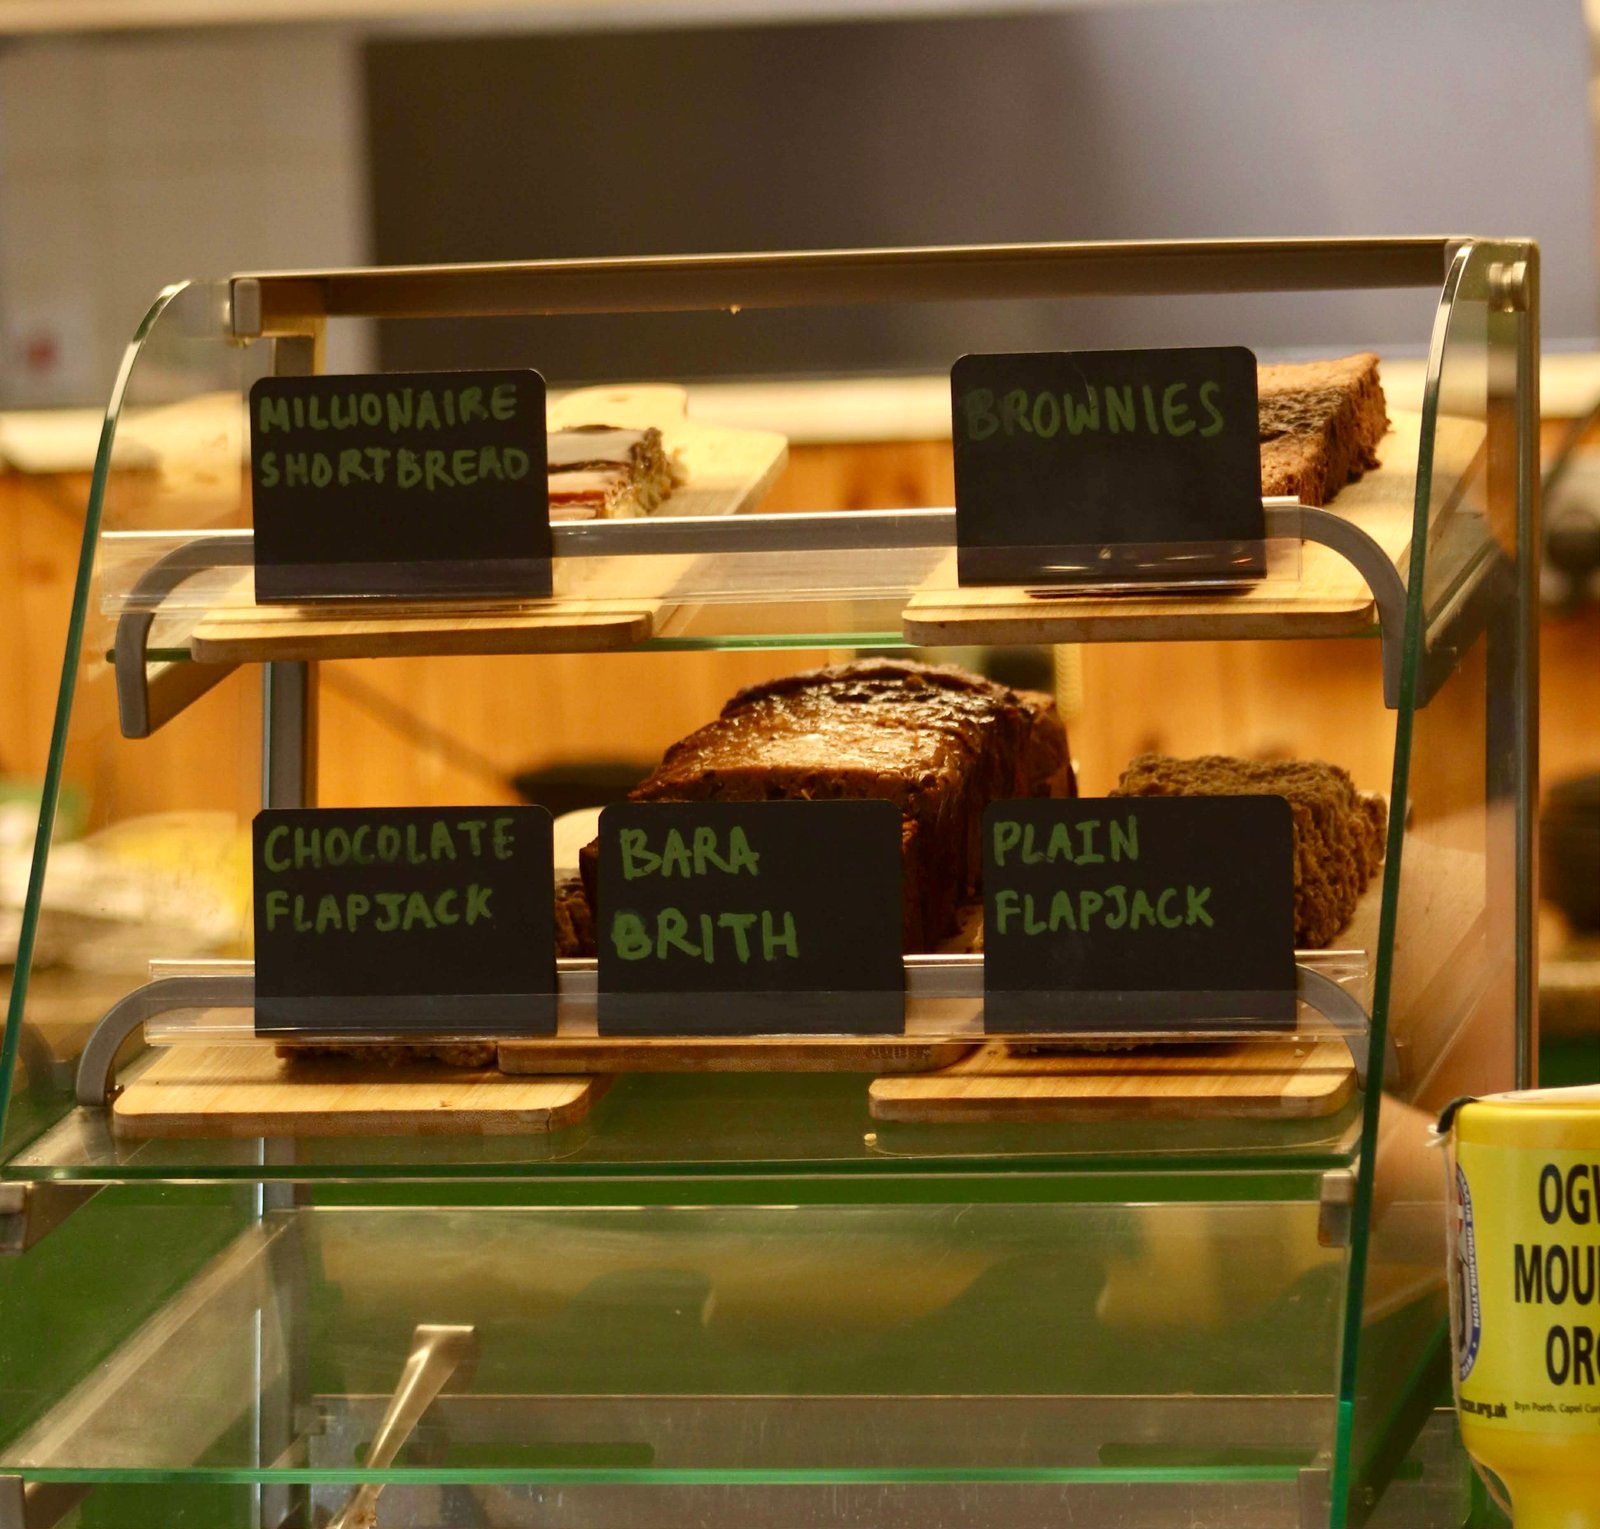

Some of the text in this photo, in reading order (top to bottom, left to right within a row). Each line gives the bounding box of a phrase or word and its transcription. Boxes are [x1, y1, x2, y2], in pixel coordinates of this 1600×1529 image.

[258, 384, 517, 433] MILLIONAIRE
[962, 380, 1224, 441] BROWNIES
[260, 446, 530, 491] SHORTBREAD
[264, 818, 514, 872] CHOCOLATE
[619, 826, 760, 880] BARA
[993, 815, 1139, 866] PLAIN
[265, 883, 493, 933] FLAPJACK
[994, 885, 1214, 935] FLAPJACK
[611, 907, 799, 964] BRITH
[1514, 1244, 1600, 1305] MOU
[1546, 1325, 1600, 1386] OR
